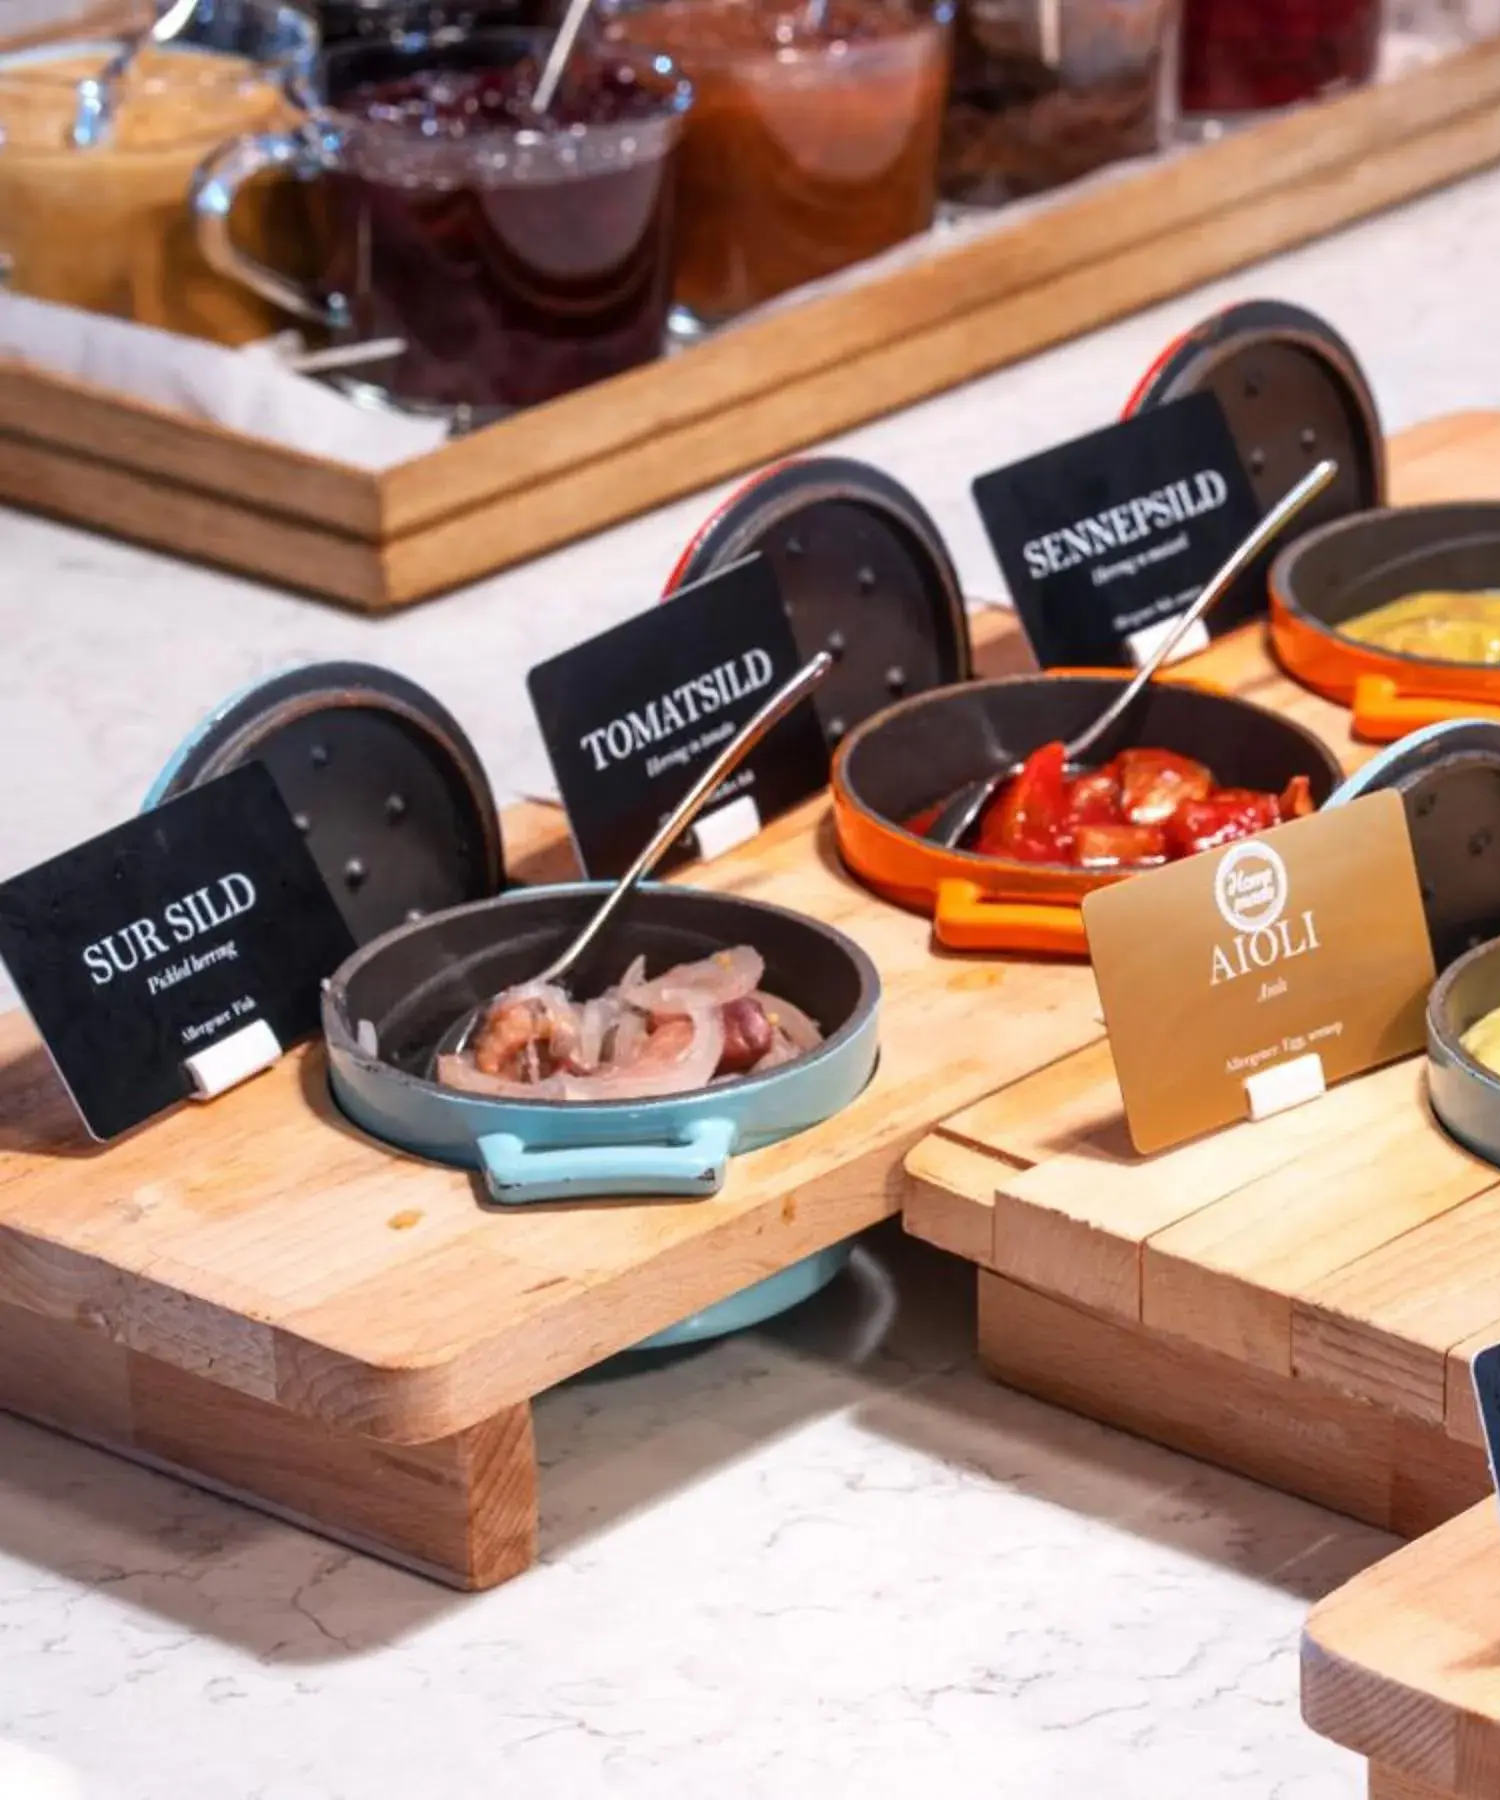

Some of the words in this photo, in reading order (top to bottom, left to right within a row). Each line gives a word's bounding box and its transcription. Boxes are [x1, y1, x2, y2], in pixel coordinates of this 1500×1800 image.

[1023, 469, 1228, 579] SENNEPSILD
[580, 648, 774, 771] TOMATSILD
[82, 917, 170, 984] SUR
[164, 872, 256, 943] SILD
[147, 954, 192, 995] Pickled
[189, 940, 239, 973] herring
[1210, 910, 1320, 986] AIOLI
